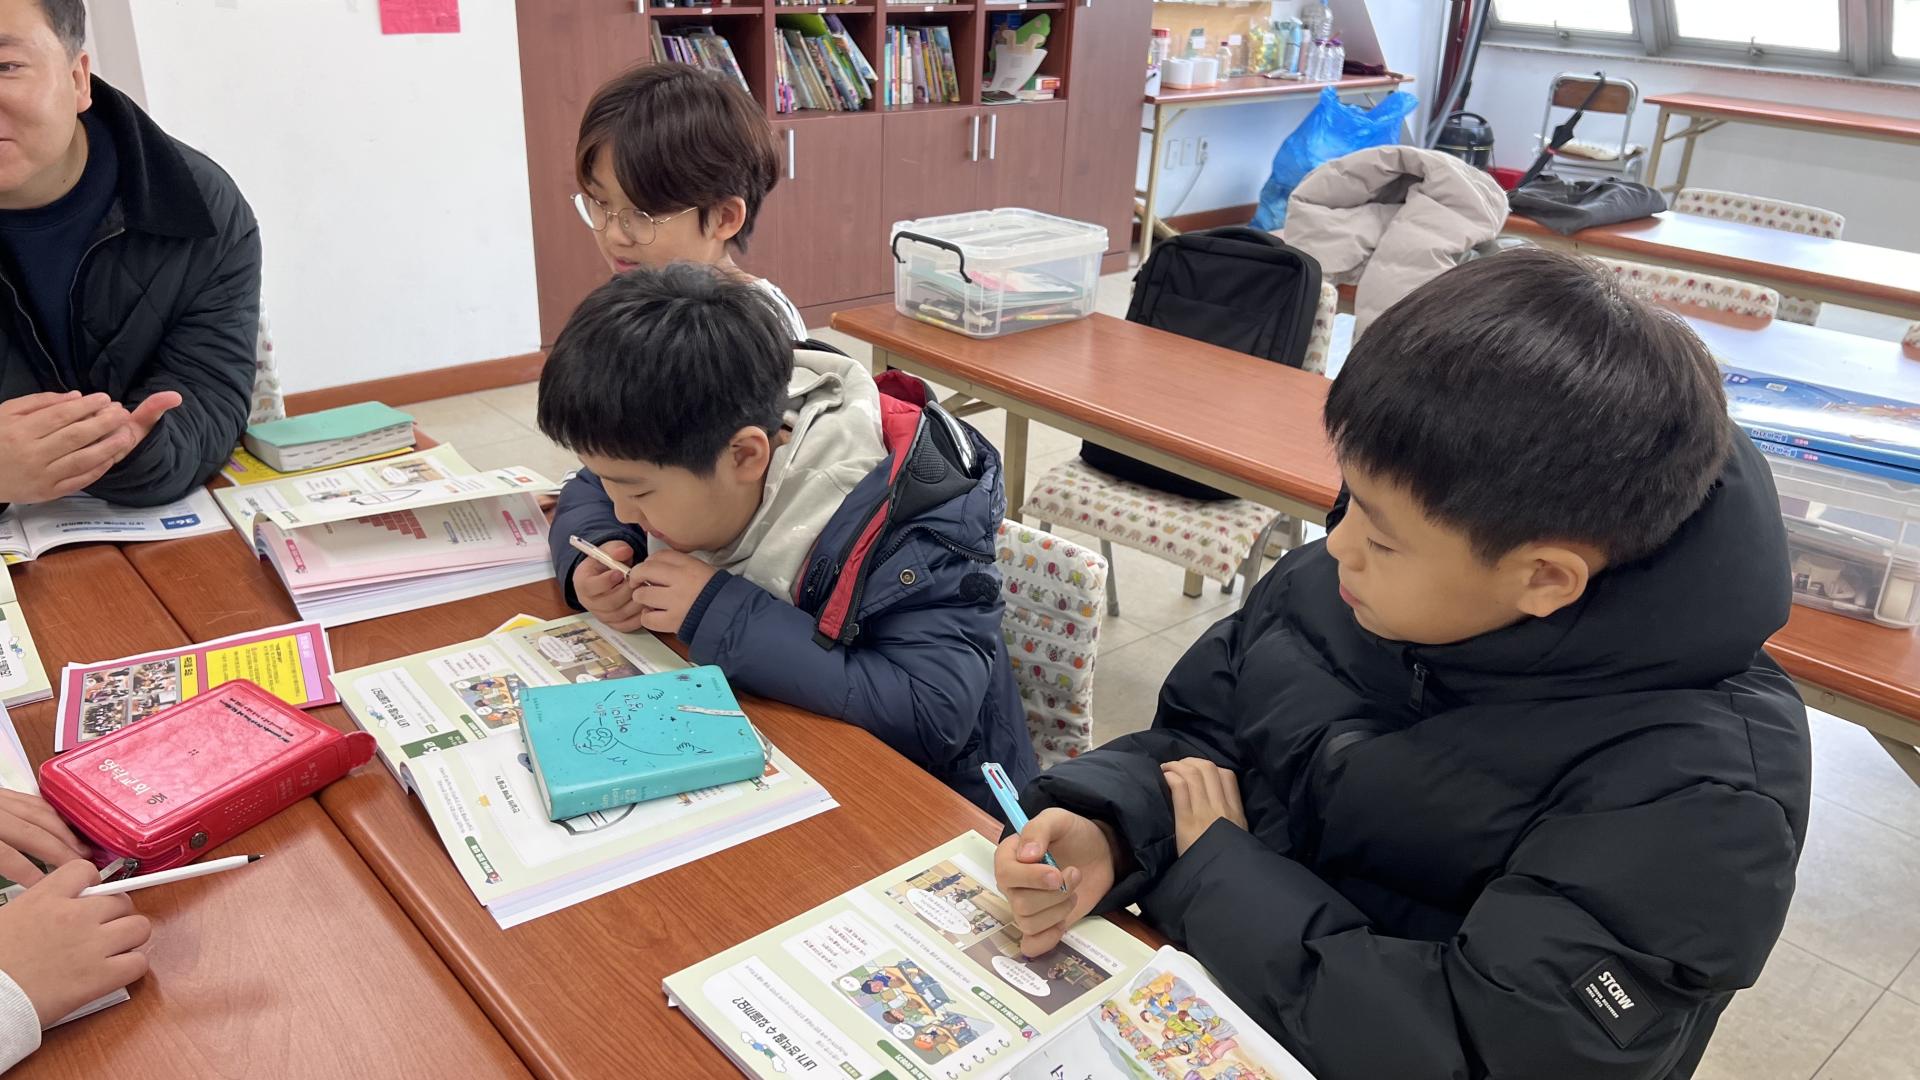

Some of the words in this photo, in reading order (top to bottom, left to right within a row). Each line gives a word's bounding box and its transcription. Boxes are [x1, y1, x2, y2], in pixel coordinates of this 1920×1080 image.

[1598, 971, 1635, 1010] STCRW
[731, 996, 771, 1029] 있을까요?
[765, 1025, 778, 1035] 수
[771, 1032, 802, 1058] 정직할
[796, 1052, 819, 1072] 내가
